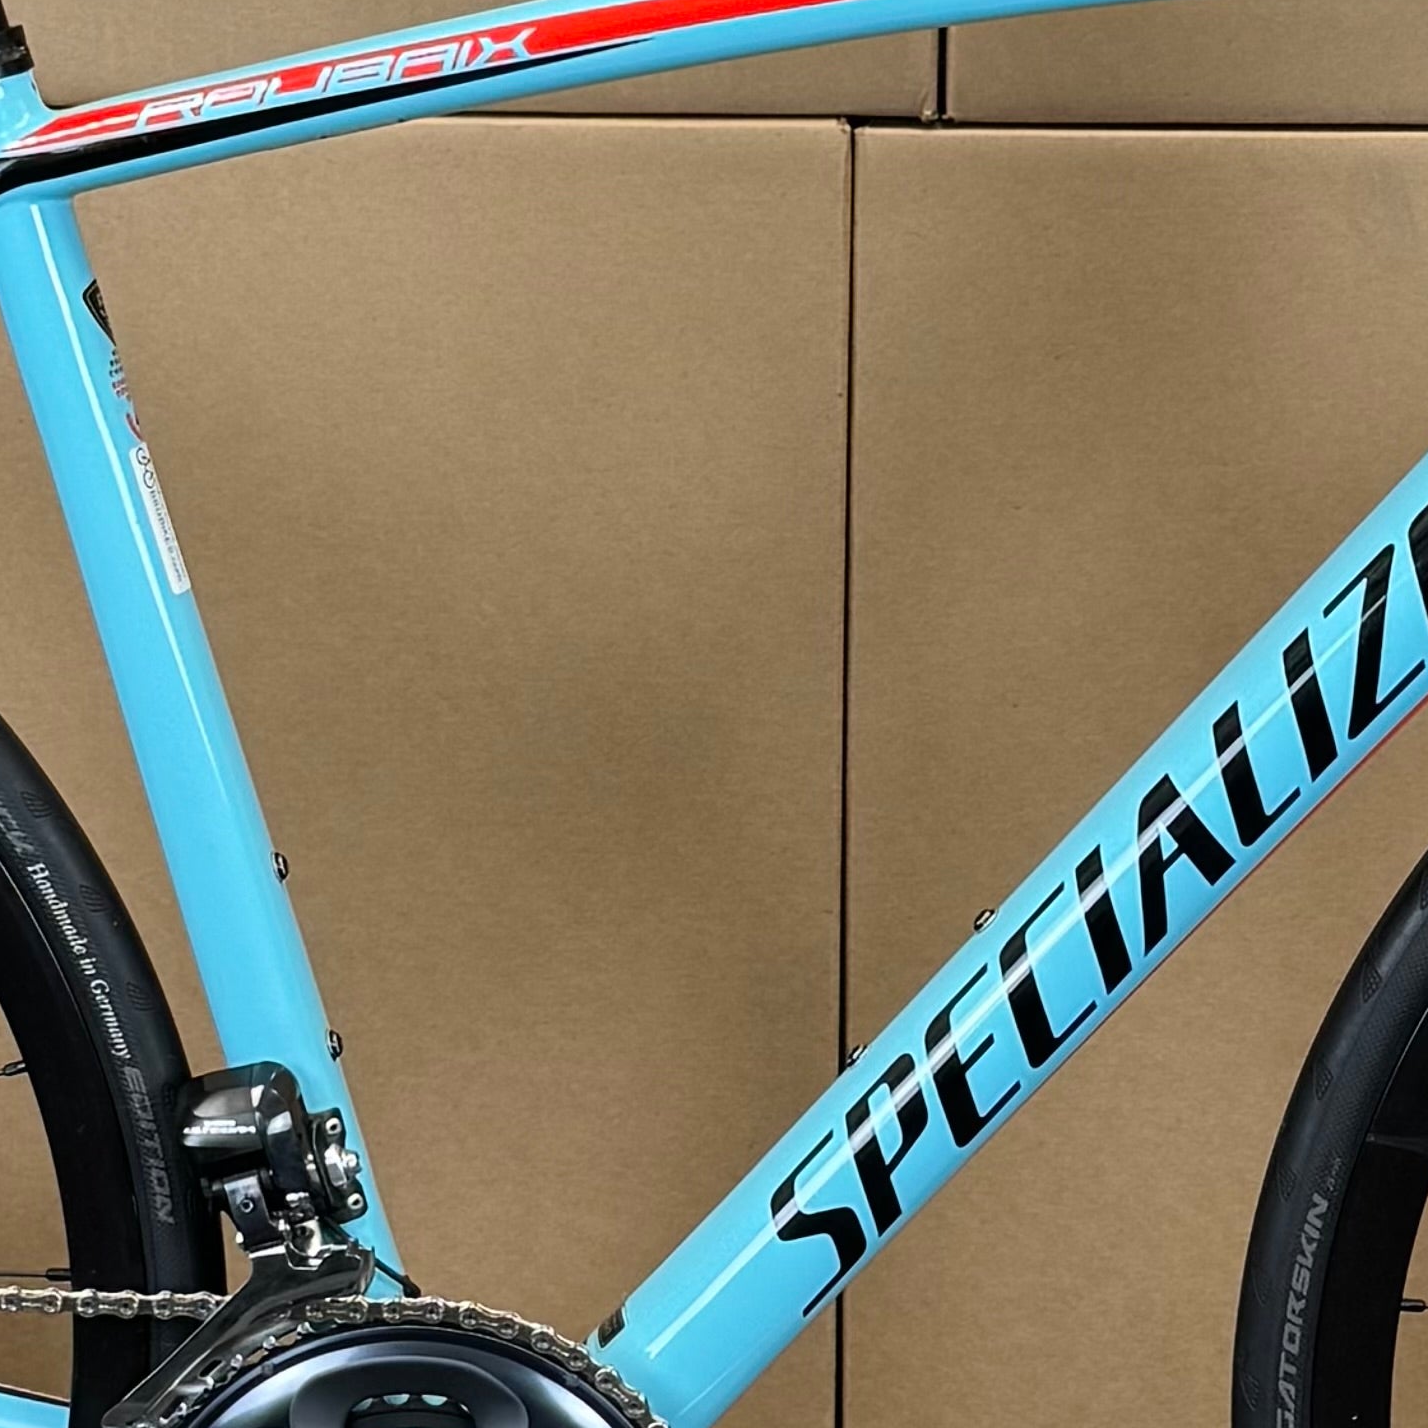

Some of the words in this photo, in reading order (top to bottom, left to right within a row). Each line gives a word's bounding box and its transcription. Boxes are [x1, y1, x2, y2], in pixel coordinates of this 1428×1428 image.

[135, 27, 539, 130] ROUBAIX
[27, 862, 87, 955] Handmade
[79, 956, 97, 977] in
[90, 978, 132, 1060] Germany
